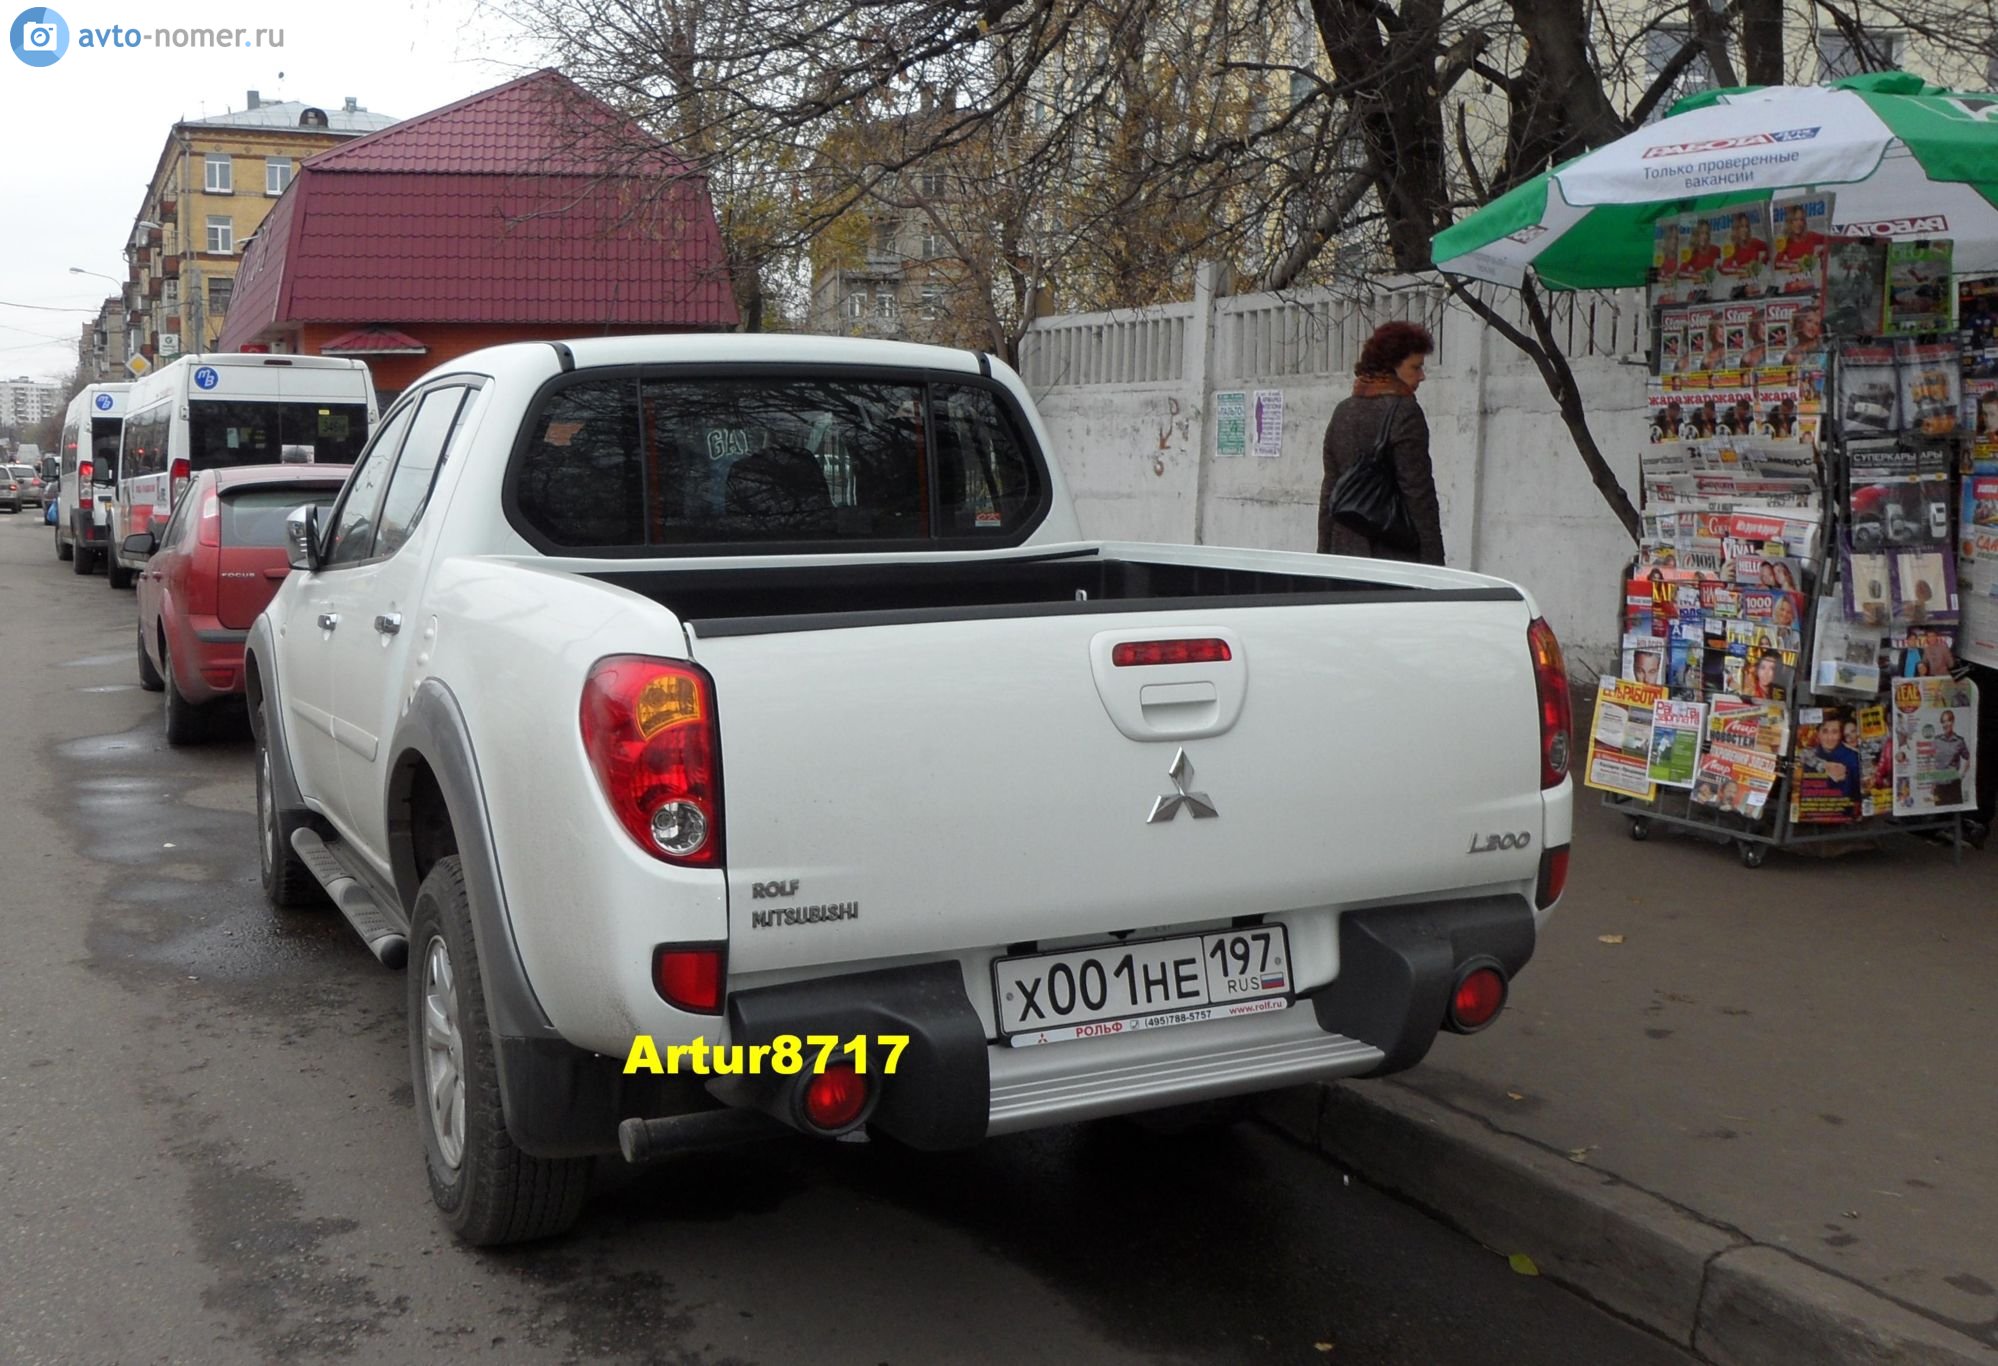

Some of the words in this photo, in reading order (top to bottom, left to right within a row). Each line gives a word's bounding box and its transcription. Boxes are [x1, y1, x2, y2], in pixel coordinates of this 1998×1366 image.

[1644, 162, 1694, 180] Только
[1698, 151, 1800, 174] проверенные
[1685, 170, 1754, 189] вакансии
[1853, 452, 1917, 462] СУПЕРКАРЫ
[1746, 596, 1772, 609] 1000
[1466, 831, 1531, 855] L200
[752, 879, 800, 899] ROLF
[752, 901, 859, 929] MITSUBISHI
[1209, 932, 1271, 977] 197
[1227, 977, 1260, 994] RUS
[1075, 1021, 1123, 1038] РОЛЬФ
[1144, 1010, 1212, 1028] (495)788-5757
[1228, 1000, 1283, 1016] www.rolf.ru
